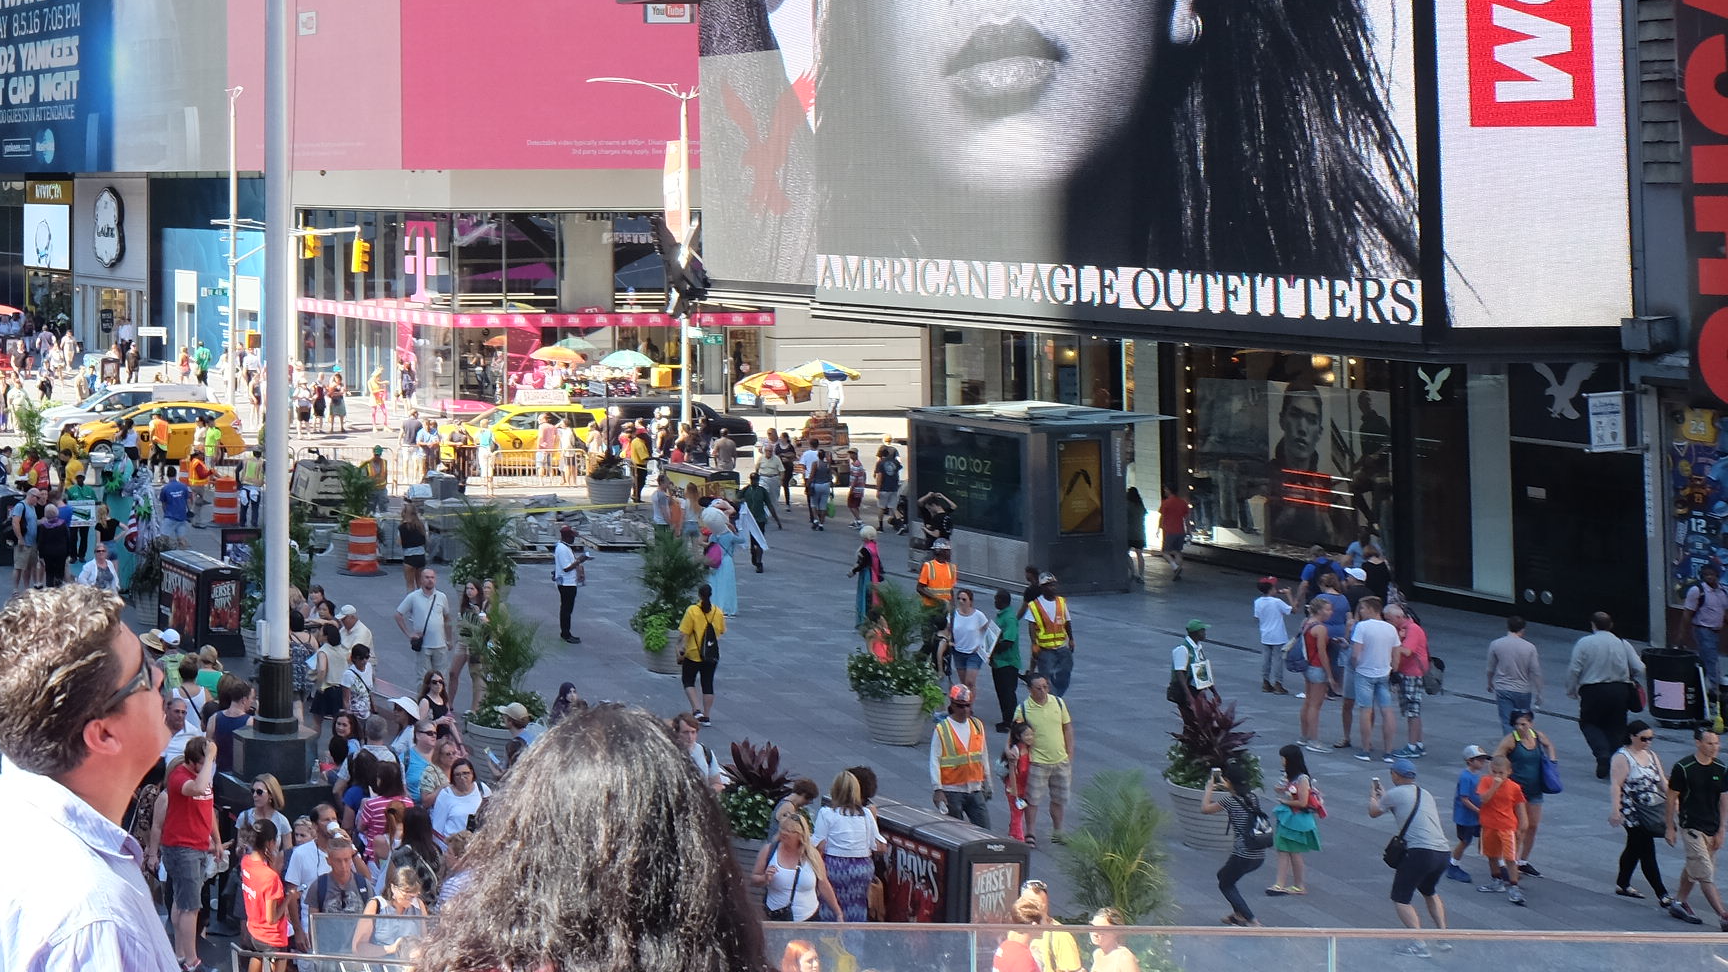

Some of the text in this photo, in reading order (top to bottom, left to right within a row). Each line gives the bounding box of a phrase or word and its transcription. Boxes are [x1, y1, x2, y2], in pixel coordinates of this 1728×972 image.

[13, 11, 40, 36] 8.5.16
[43, 6, 63, 30] 7:05
[65, 3, 81, 27] PM
[19, 36, 79, 71] YANKEES
[8, 76, 34, 105] CAP
[39, 70, 80, 102] NIGHT
[815, 254, 1418, 326] AMERICAN EAGLE OUTFITTERS
[1690, 518, 1707, 534] 12
[212, 580, 236, 599] JERSEY
[975, 867, 1013, 895] JERSEY
[979, 892, 1006, 912] BOYS
